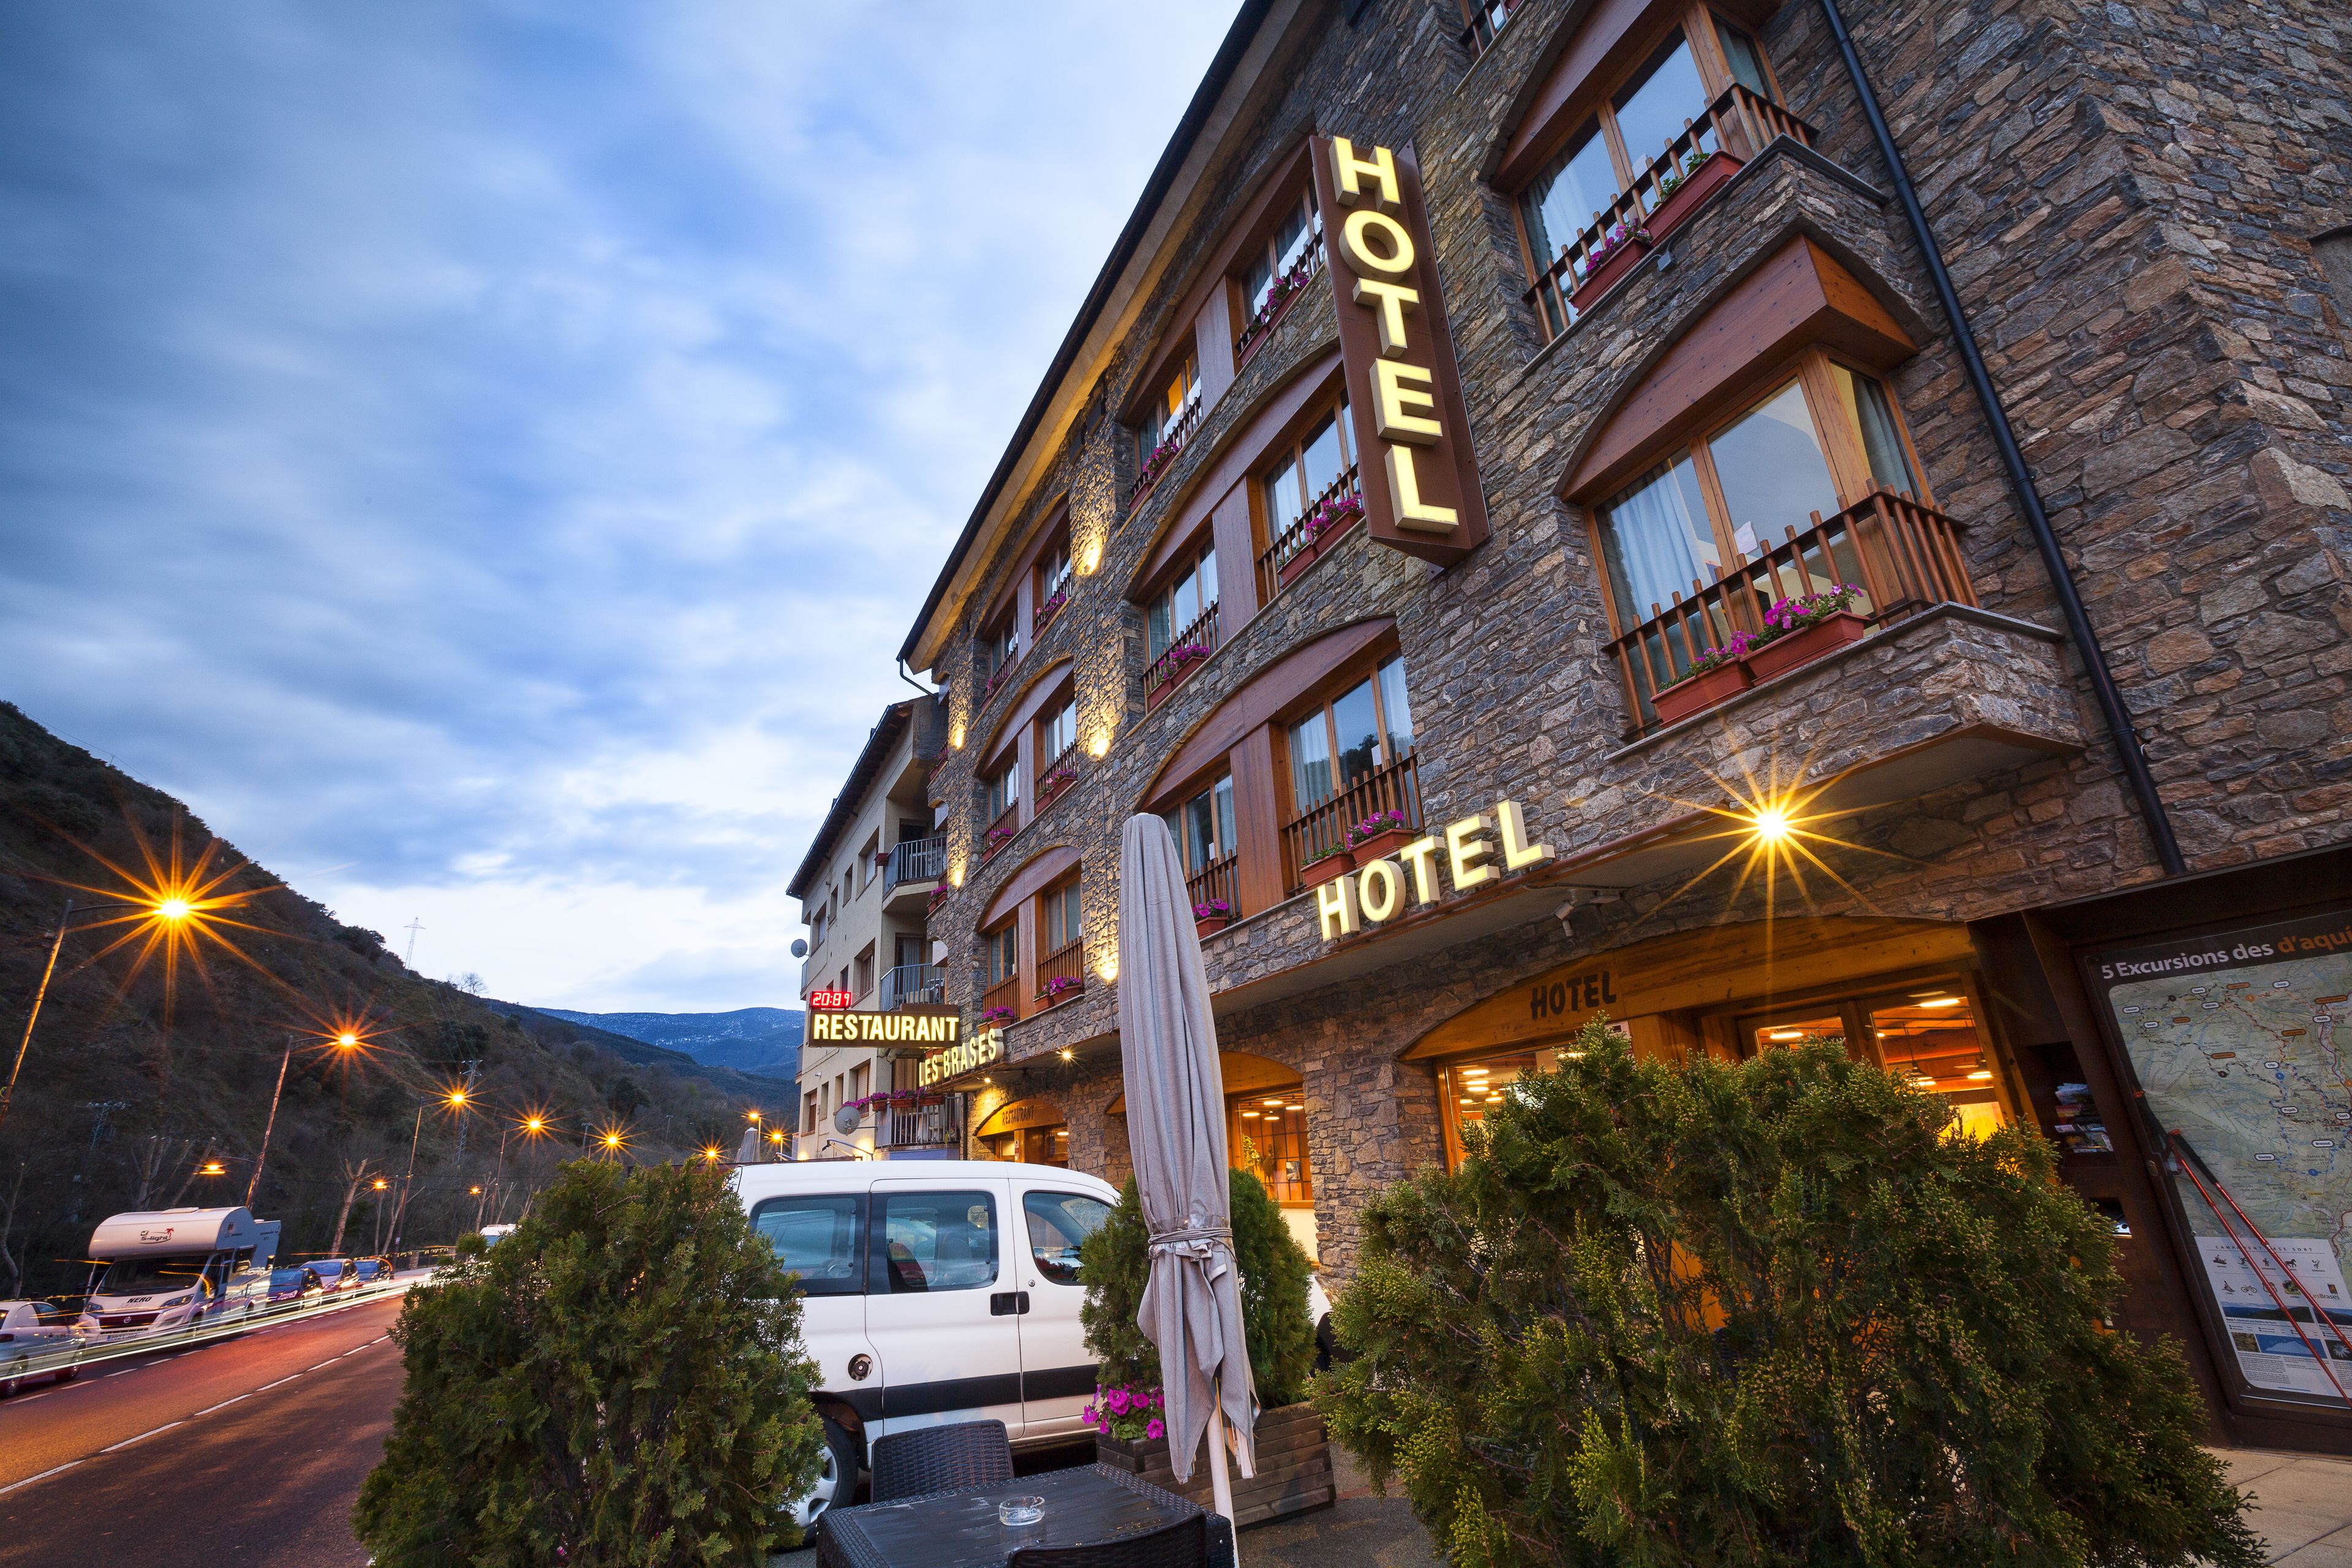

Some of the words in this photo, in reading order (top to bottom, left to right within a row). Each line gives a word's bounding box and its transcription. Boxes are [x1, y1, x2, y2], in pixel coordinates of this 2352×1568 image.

[1330, 135, 1460, 532] HOTEL
[1317, 799, 1555, 942] HOTEL
[2101, 965, 2114, 979] 5
[2116, 949, 2230, 977] Excursions
[2233, 943, 2274, 961] des
[1531, 971, 1617, 1019] HOTEL
[813, 1014, 959, 1041] RESTAURANT
[919, 1055, 940, 1087] LES
[943, 1028, 1004, 1078] BRASES
[1002, 1104, 1035, 1126] RESTAURANT
